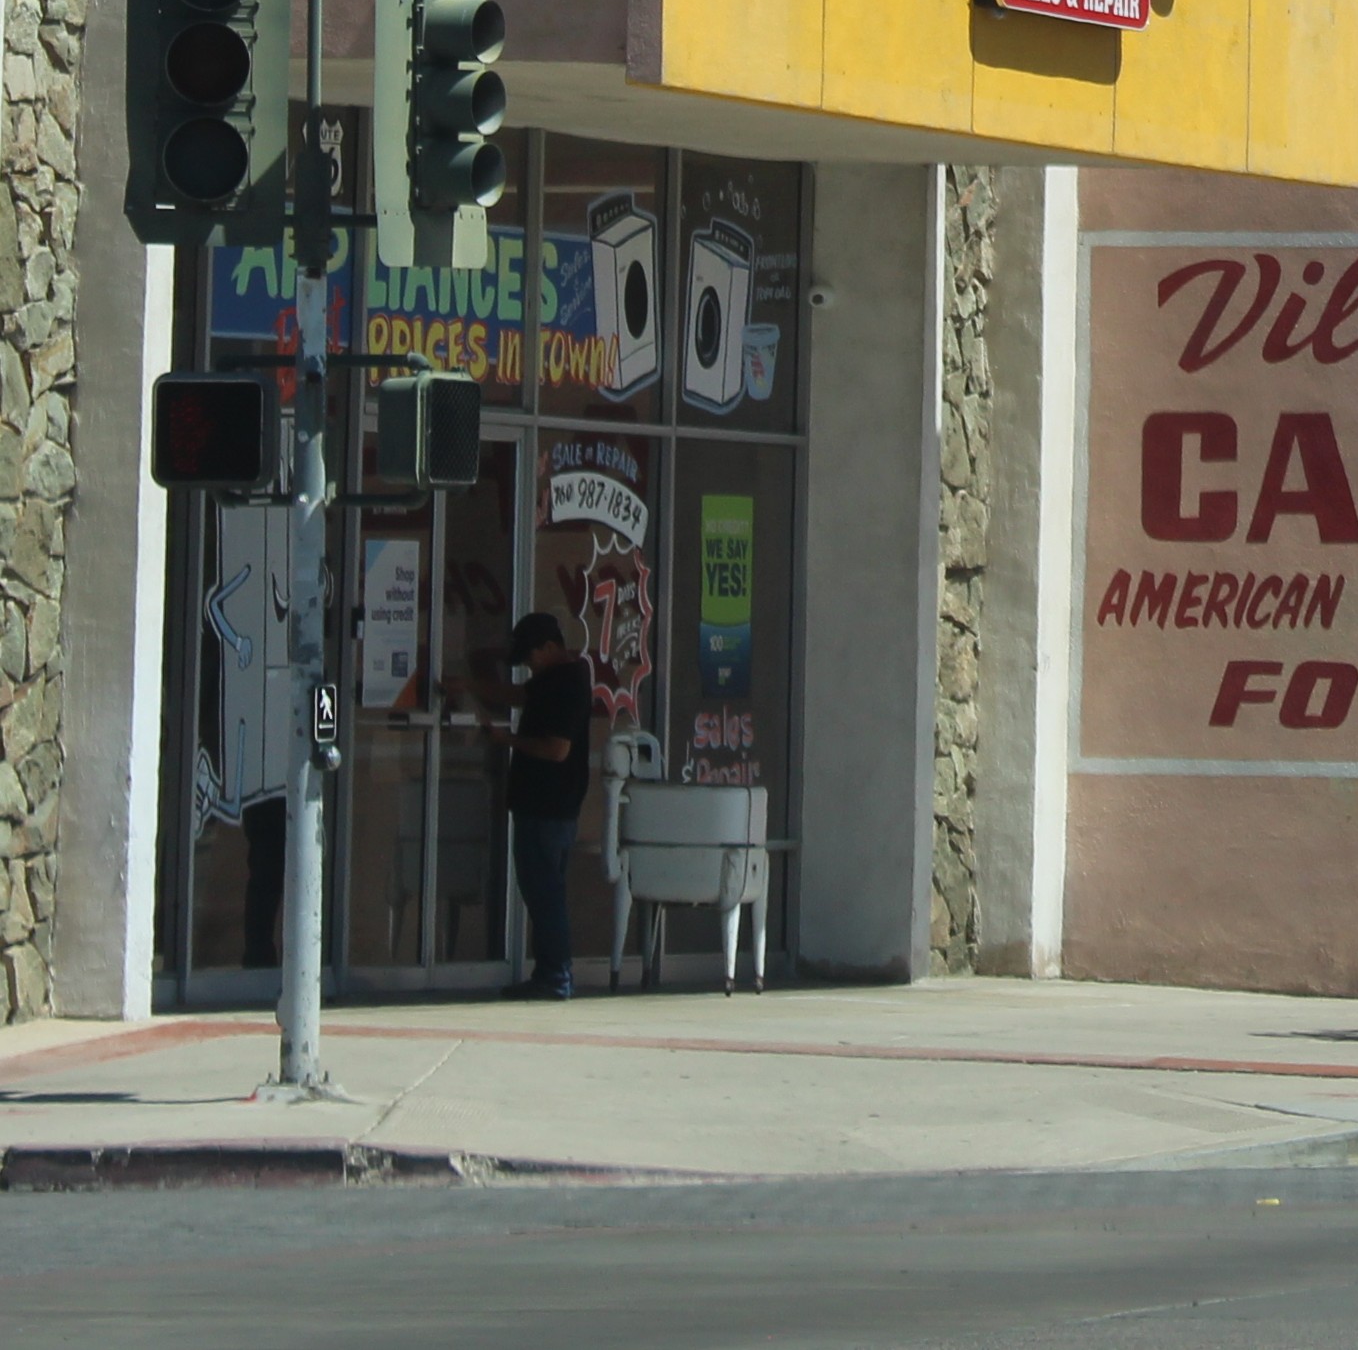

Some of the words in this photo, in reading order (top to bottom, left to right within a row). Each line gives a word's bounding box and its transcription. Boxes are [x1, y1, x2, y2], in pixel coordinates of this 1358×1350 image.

[706, 539, 722, 559] WE
[727, 539, 748, 560] SAY
[396, 567, 415, 585] Shop
[706, 563, 747, 598] YES!
[386, 587, 414, 602] without
[1097, 569, 1345, 631] AMERICAN
[371, 607, 392, 624] using
[393, 607, 414, 621] credit
[593, 579, 616, 663] 7
